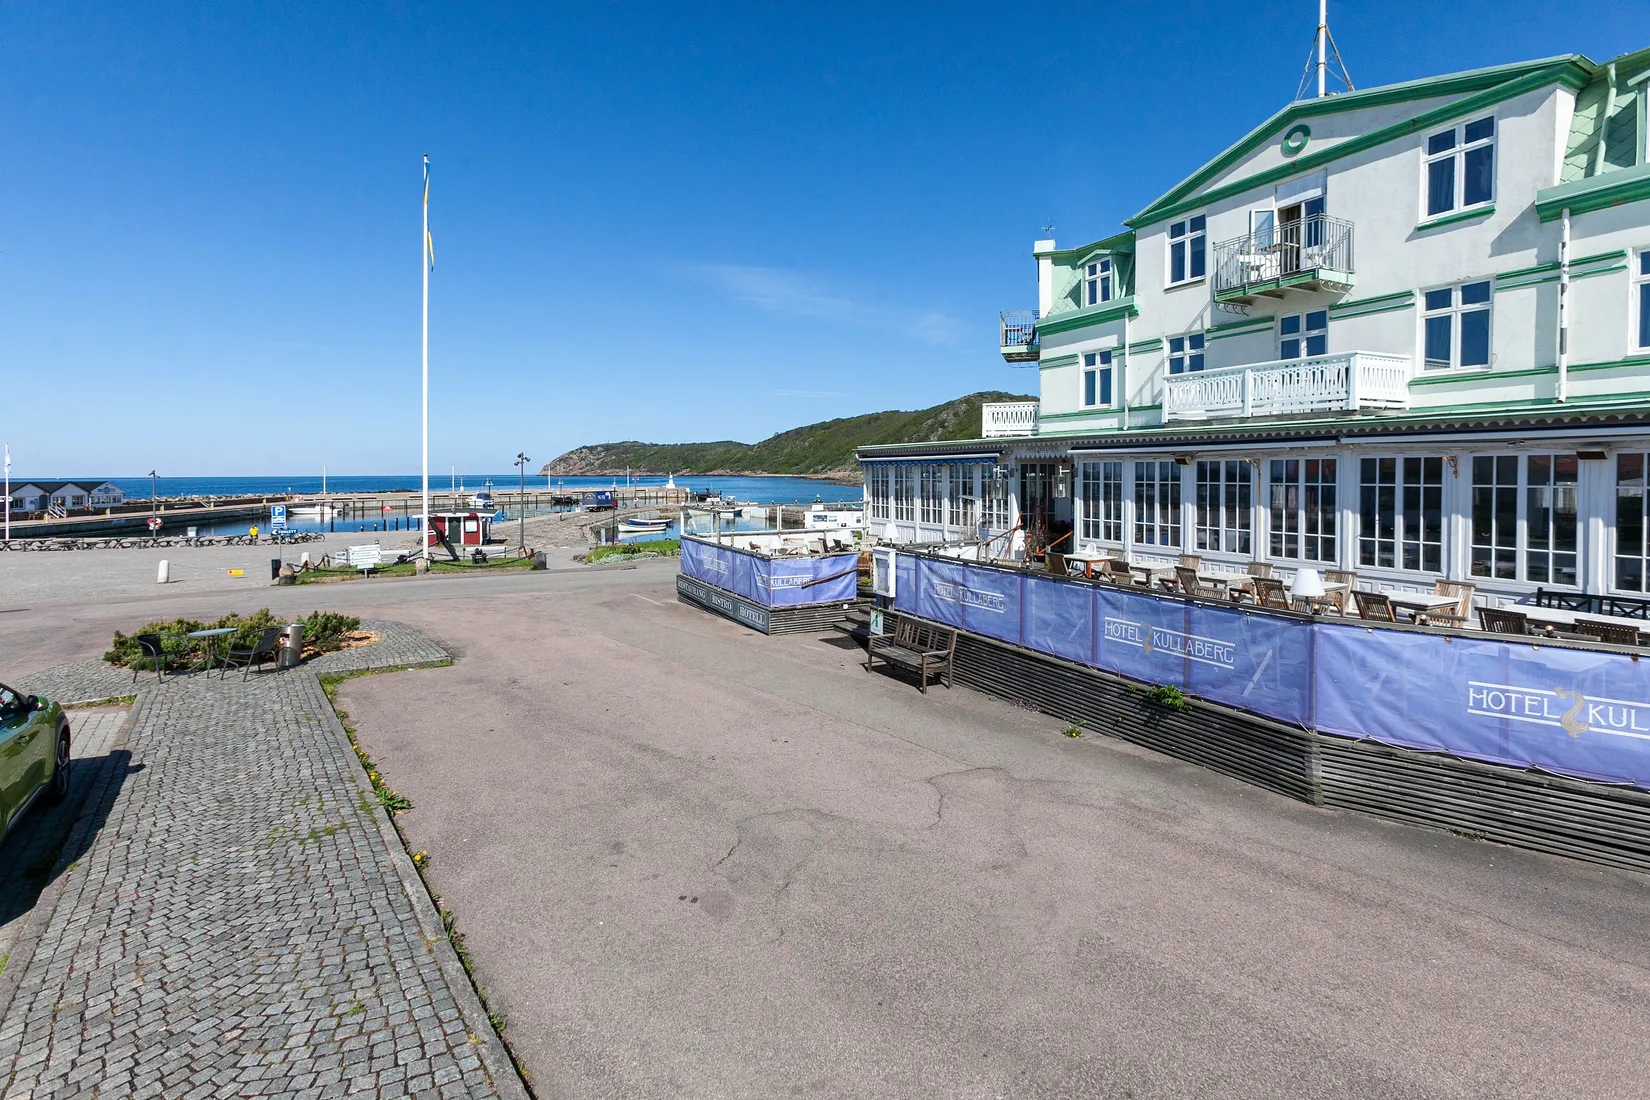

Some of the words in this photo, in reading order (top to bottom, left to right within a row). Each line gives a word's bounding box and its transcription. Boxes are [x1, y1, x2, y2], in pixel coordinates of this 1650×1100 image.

[712, 594, 732, 610] BISTRO
[934, 583, 954, 598] HOTEL
[960, 588, 1004, 609] KULLABERG
[740, 606, 764, 625] HOTELL
[1104, 621, 1142, 642] HOTEL
[1153, 632, 1234, 663] KULLABERG
[1468, 688, 1562, 718] HOTEL
[1588, 704, 1650, 732] KUL
